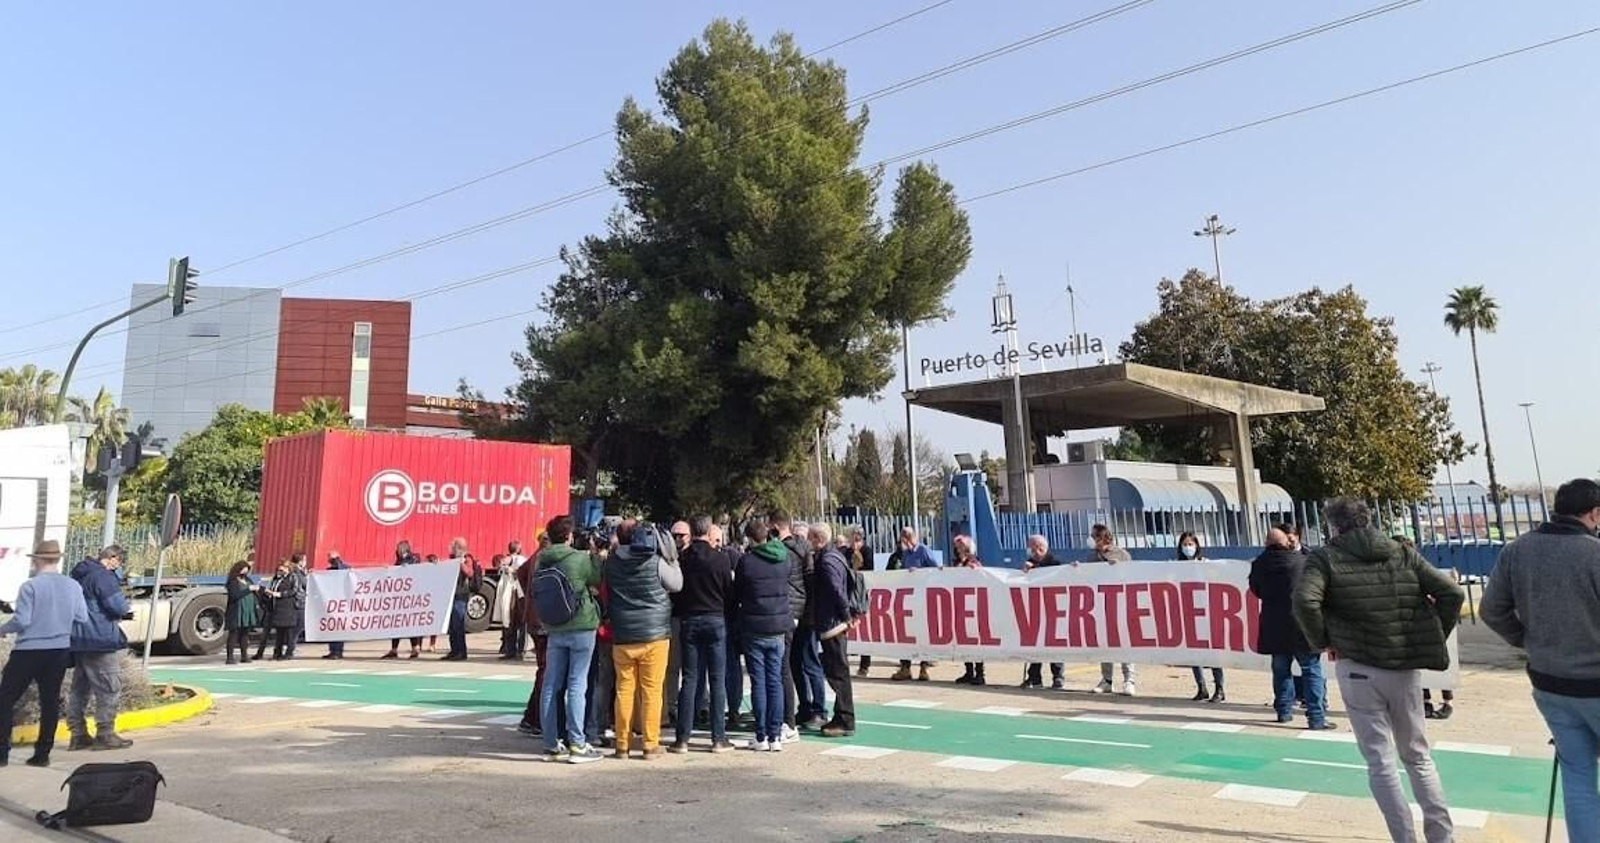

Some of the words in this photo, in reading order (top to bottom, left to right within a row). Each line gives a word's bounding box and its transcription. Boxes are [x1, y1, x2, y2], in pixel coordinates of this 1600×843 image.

[920, 352, 986, 377] Puerto
[993, 344, 1020, 366] de
[1028, 332, 1103, 361] Sevilla
[376, 480, 408, 515] B
[418, 481, 537, 506] BOLUDA
[416, 504, 458, 516] LINES
[354, 580, 371, 594] 25
[372, 576, 414, 592] AÑOS
[326, 599, 347, 614] DE
[349, 593, 431, 612] INJUSTICIAS
[319, 616, 347, 632] SON
[350, 610, 435, 631] SUFICIENTES
[926, 587, 1002, 646] DEL
